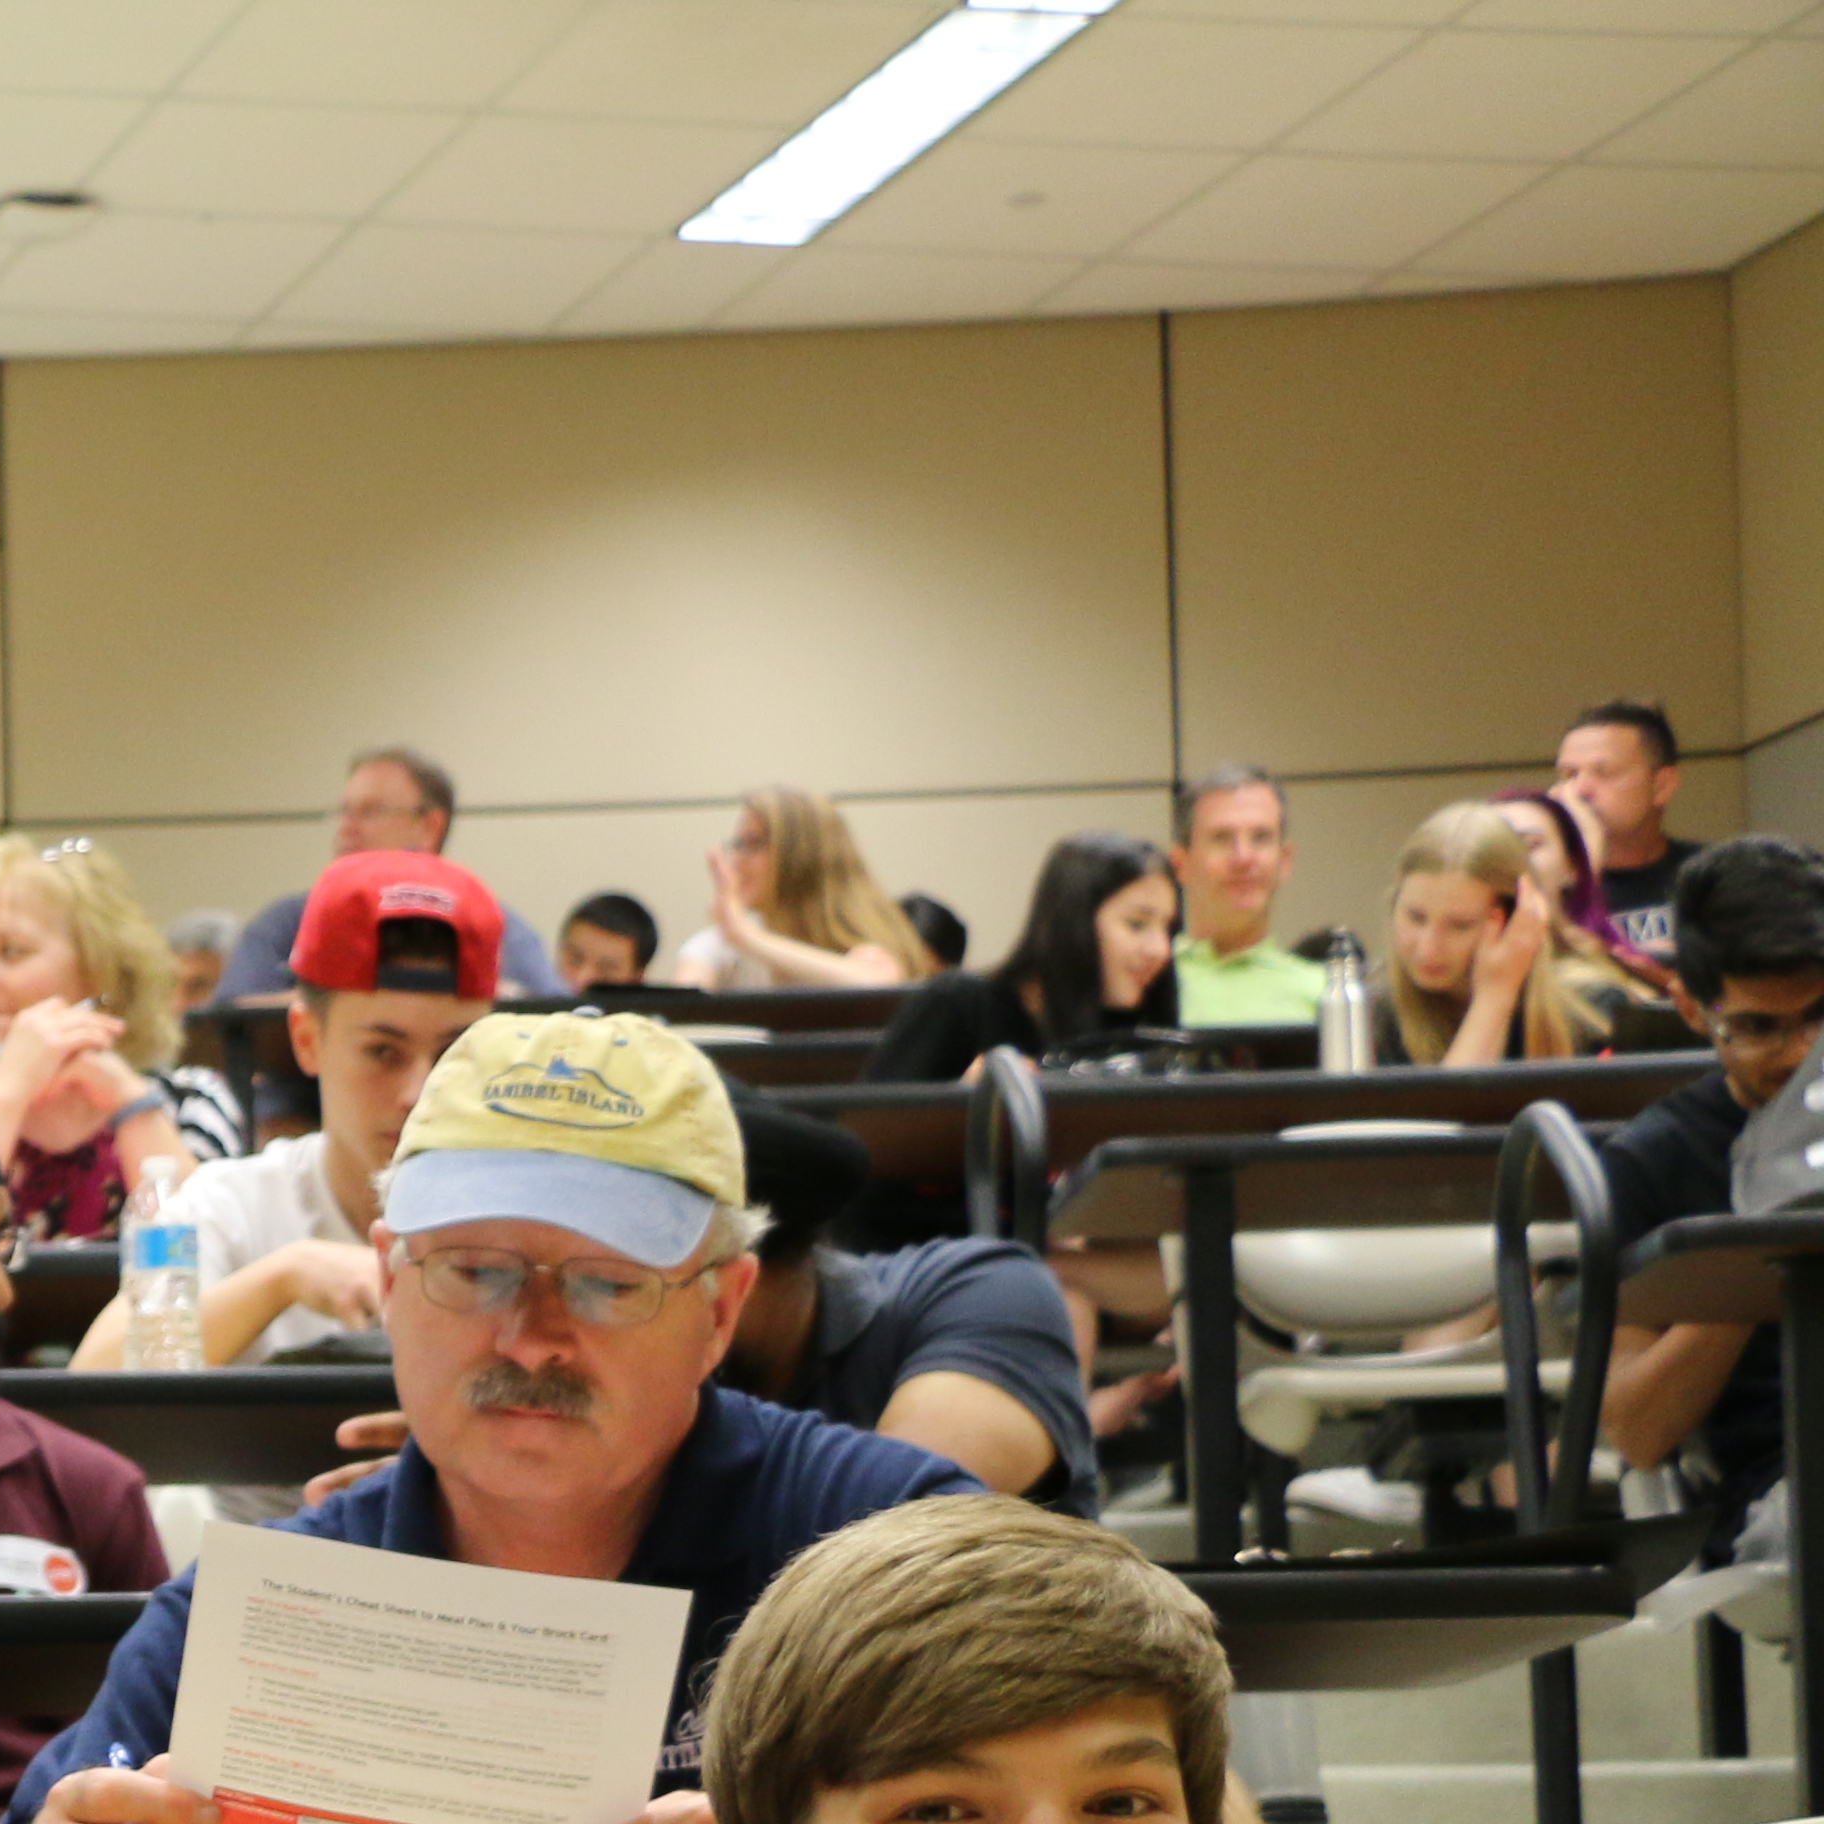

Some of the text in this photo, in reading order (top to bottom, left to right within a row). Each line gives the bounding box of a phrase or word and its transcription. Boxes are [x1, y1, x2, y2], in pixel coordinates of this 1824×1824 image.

[568, 1087, 644, 1117] ISLAND
[262, 1578, 609, 1643] The Student's Cheat Sheet to Meal Plan & Your Brock Card
